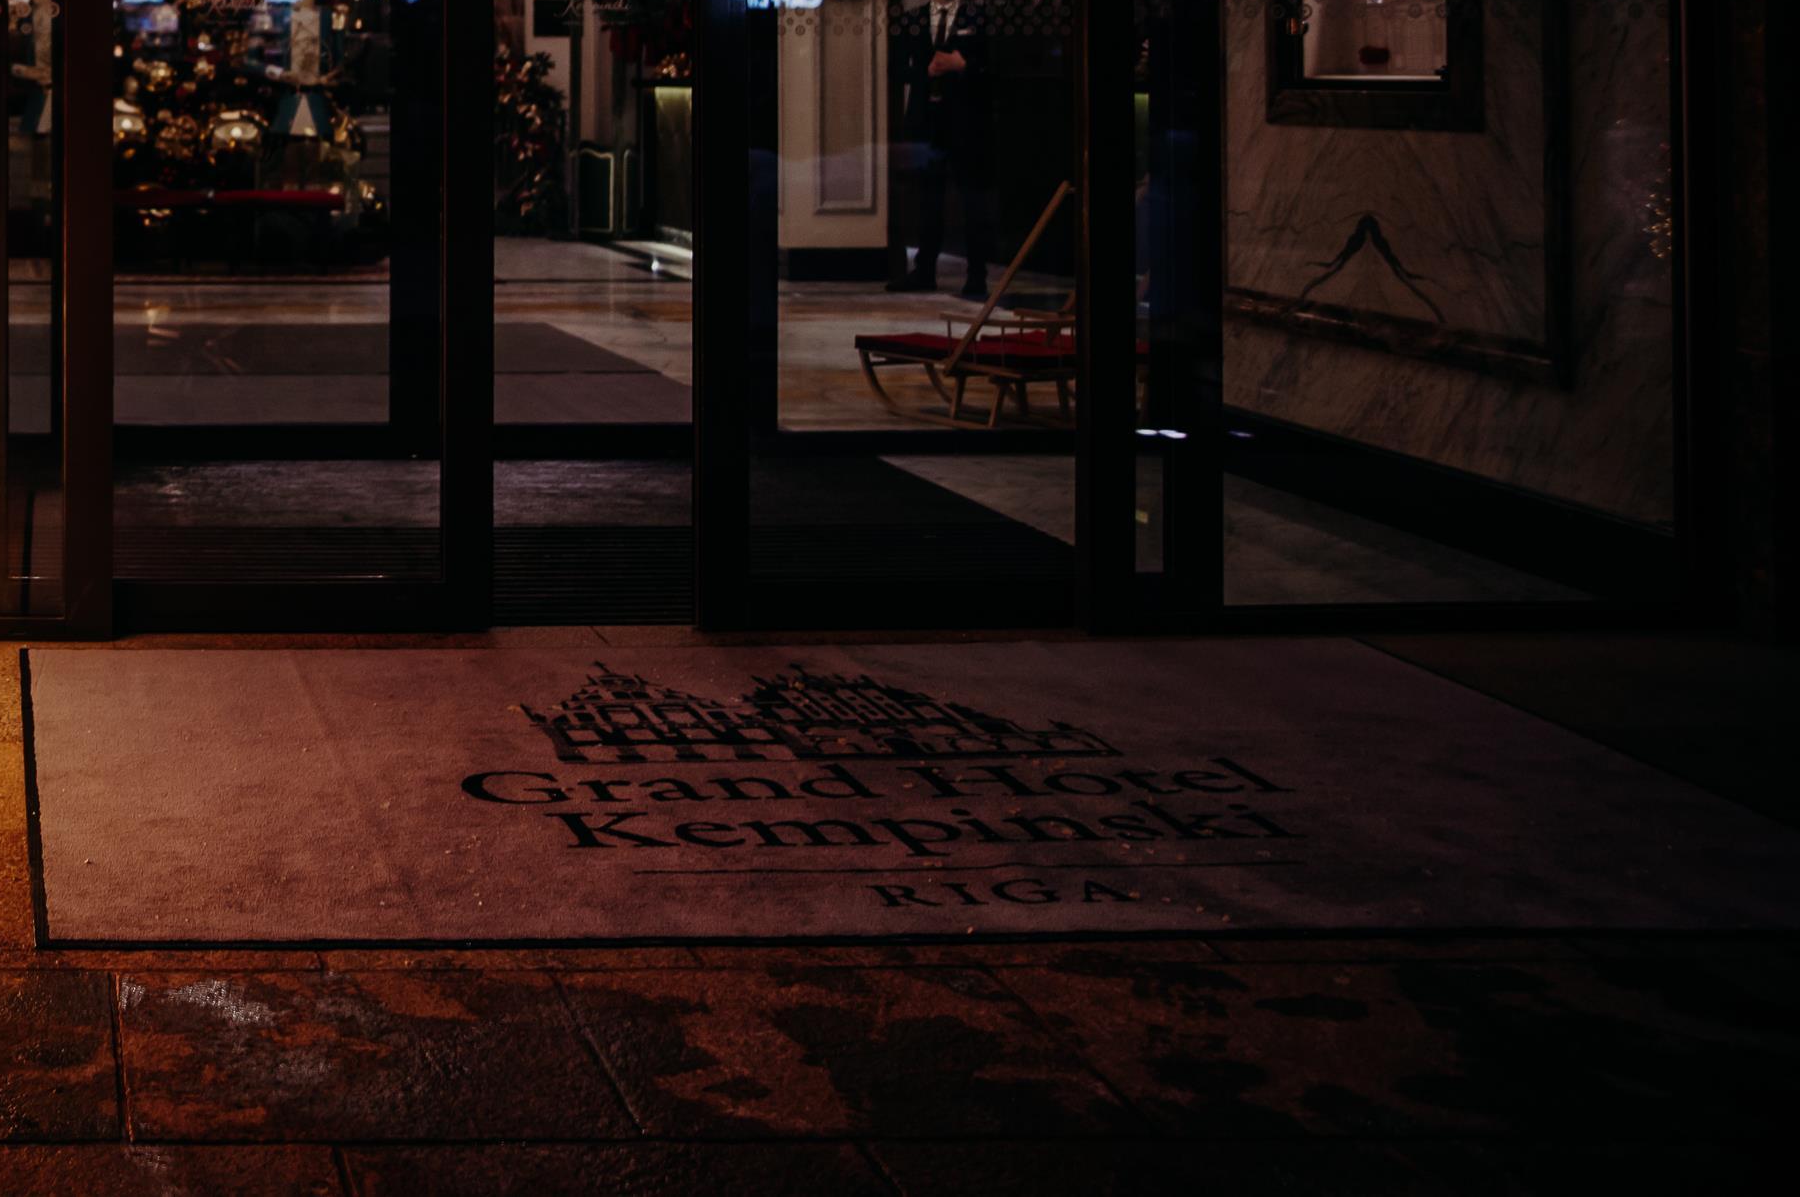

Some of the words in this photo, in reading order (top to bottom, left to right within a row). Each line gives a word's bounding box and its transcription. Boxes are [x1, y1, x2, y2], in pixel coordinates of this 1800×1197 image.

[460, 763, 887, 805] Grand
[897, 757, 1295, 799] Hotel
[546, 799, 1307, 858] Kempinski
[866, 877, 1138, 908] RIGA
